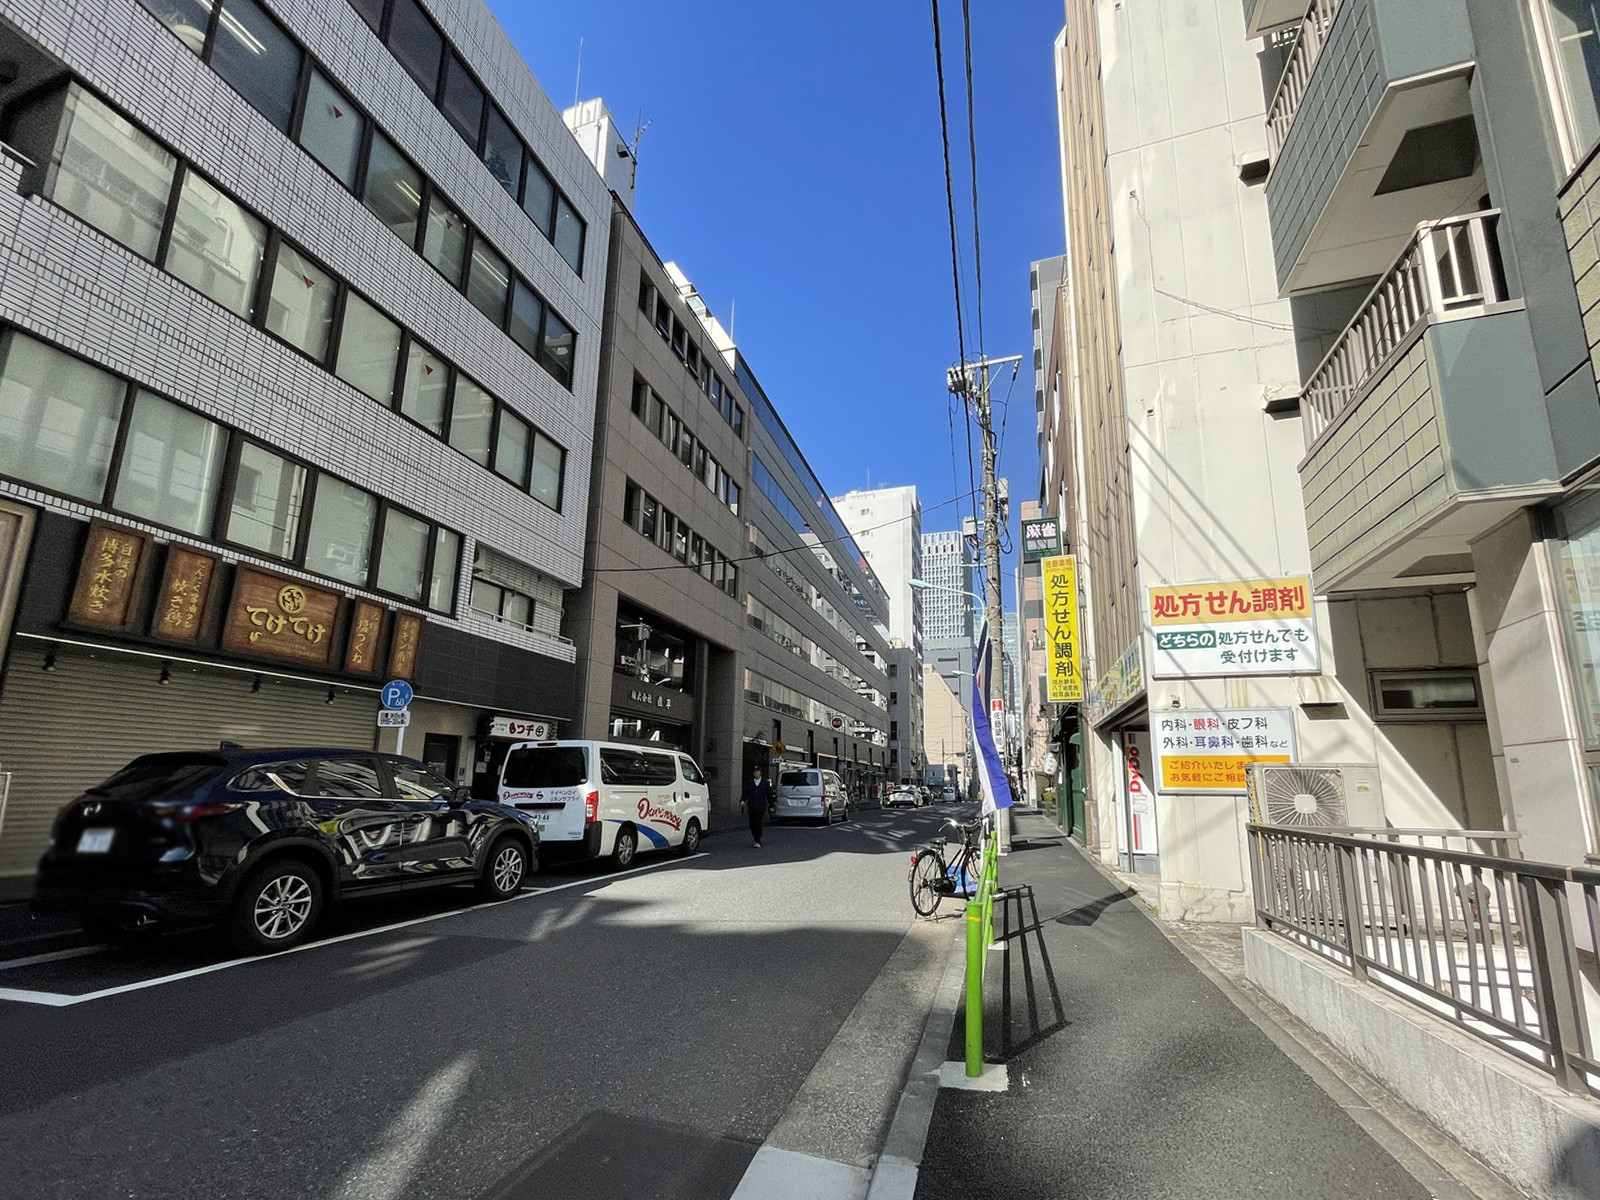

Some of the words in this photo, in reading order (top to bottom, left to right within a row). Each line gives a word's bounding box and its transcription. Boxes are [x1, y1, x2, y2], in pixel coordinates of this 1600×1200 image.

[1026, 522, 1056, 539] 麻雀
[89, 537, 120, 614] 博多水炊き
[115, 543, 133, 578] 自慢の
[1154, 585, 1305, 618] 処方せん調剤
[246, 605, 326, 643] てけてけ
[1051, 574, 1074, 677] 処方せん調剤
[1158, 628, 1309, 649] どちらの処方せんでも
[352, 619, 370, 664] 塩つくね
[1221, 648, 1299, 664] 受付けます
[387, 688, 401, 706] P
[395, 698, 405, 707] 60
[1161, 717, 1268, 731] 内科・眼科・皮フ科
[1162, 735, 1288, 749] 外科・耳鼻科・歯科など
[1128, 746, 1144, 793] DyDo
